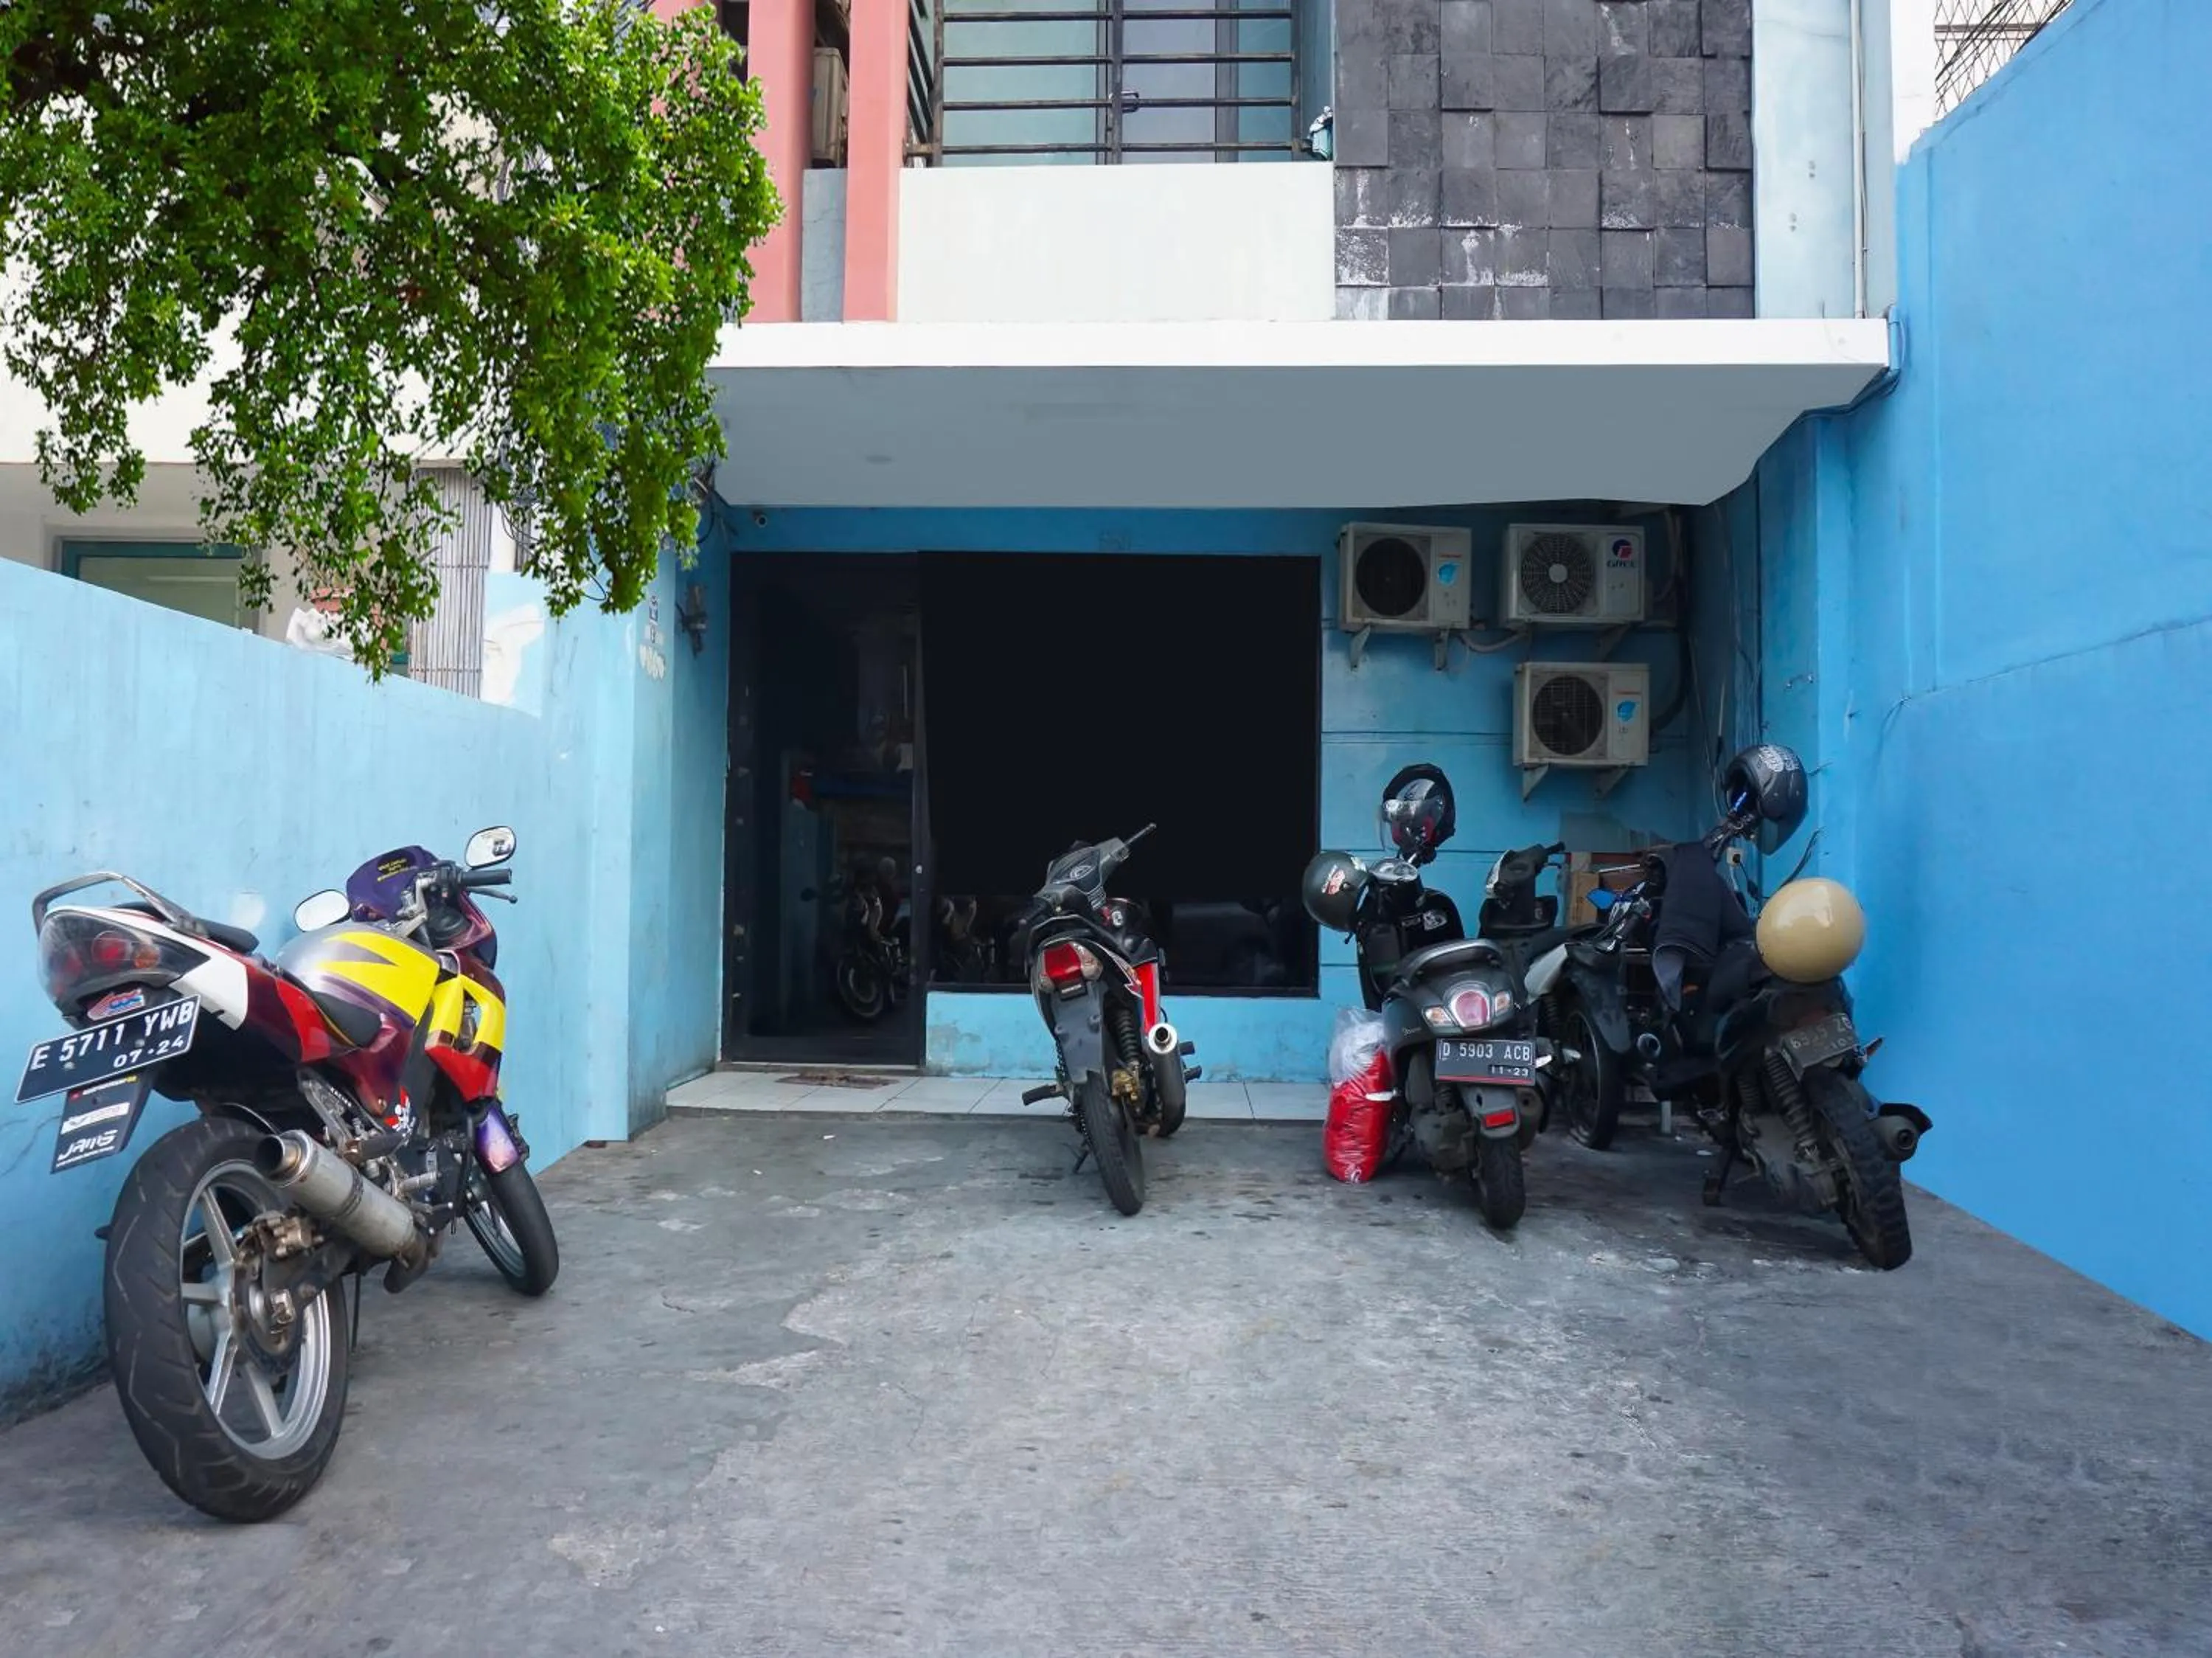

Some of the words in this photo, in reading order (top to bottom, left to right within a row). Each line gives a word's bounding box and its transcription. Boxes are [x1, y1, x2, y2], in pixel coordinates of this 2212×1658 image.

[30, 1044, 51, 1070] E
[58, 1022, 128, 1063] 5711
[144, 1001, 195, 1037] YWB
[1442, 1041, 1451, 1057] D
[1459, 1042, 1493, 1059] 5903
[1503, 1045, 1531, 1061] ACB
